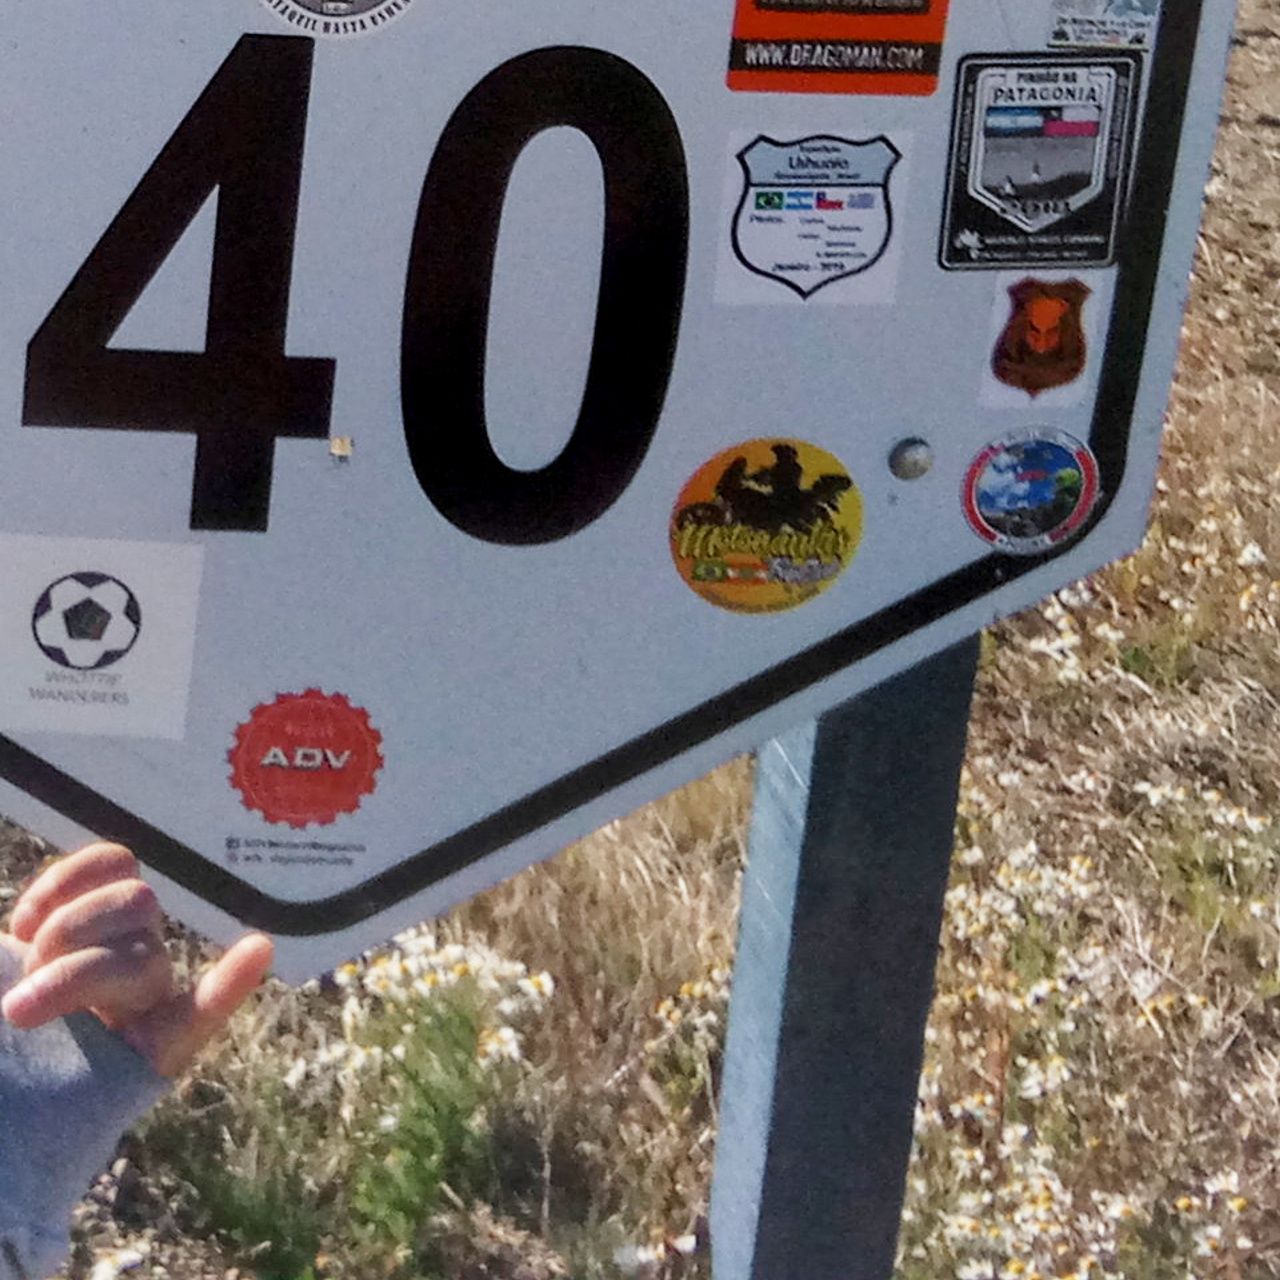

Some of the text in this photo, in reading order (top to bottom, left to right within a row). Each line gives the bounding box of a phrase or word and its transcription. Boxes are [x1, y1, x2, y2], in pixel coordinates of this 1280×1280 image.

[745, 41, 924, 69] WWW.DRAGOMAN.COM
[993, 86, 1097, 103] PATAGONIA
[22, 32, 690, 547] 40
[260, 746, 352, 770] ADV
